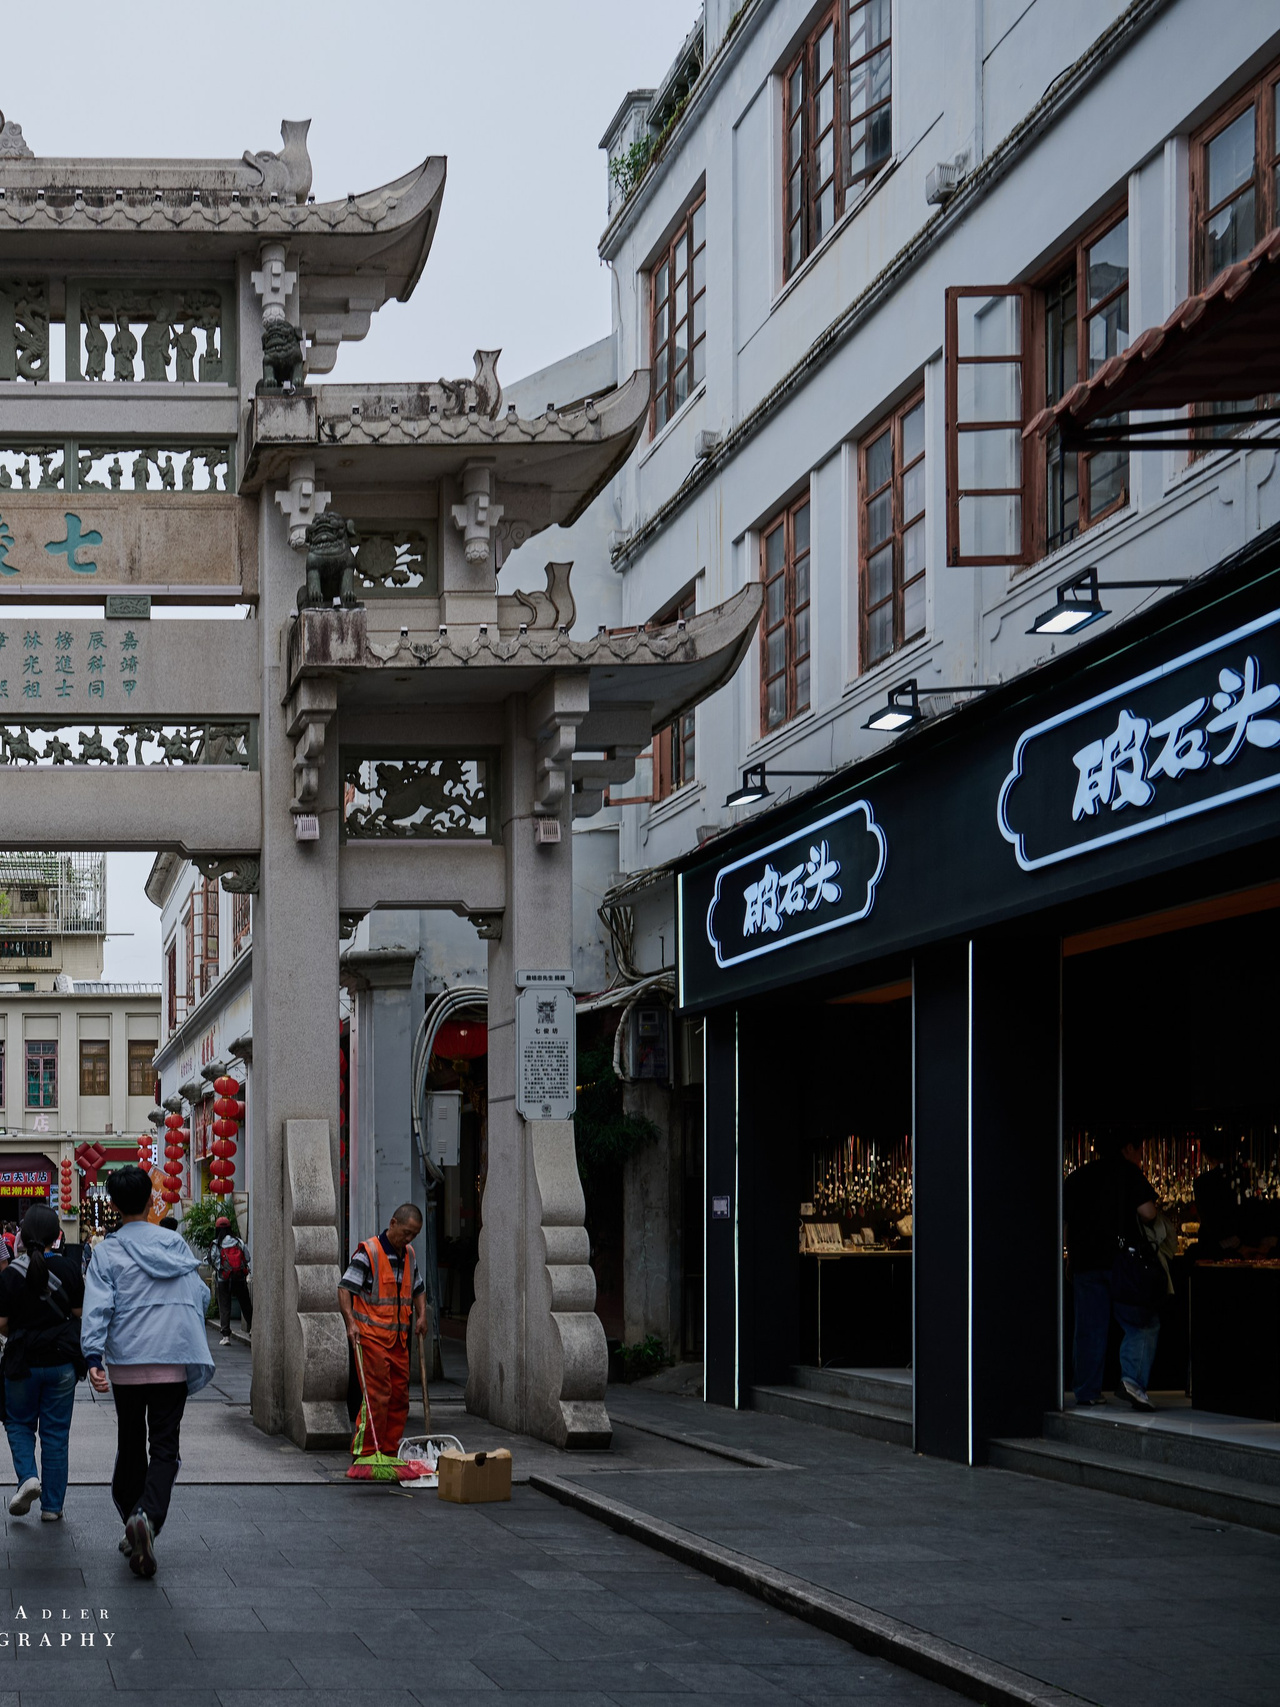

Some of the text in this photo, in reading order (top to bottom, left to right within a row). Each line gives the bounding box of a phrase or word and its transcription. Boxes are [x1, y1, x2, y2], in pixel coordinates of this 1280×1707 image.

[22, 630, 44, 699] 林光祖
[87, 630, 108, 700] 辰科同
[119, 630, 140, 698] 嘉靖甲
